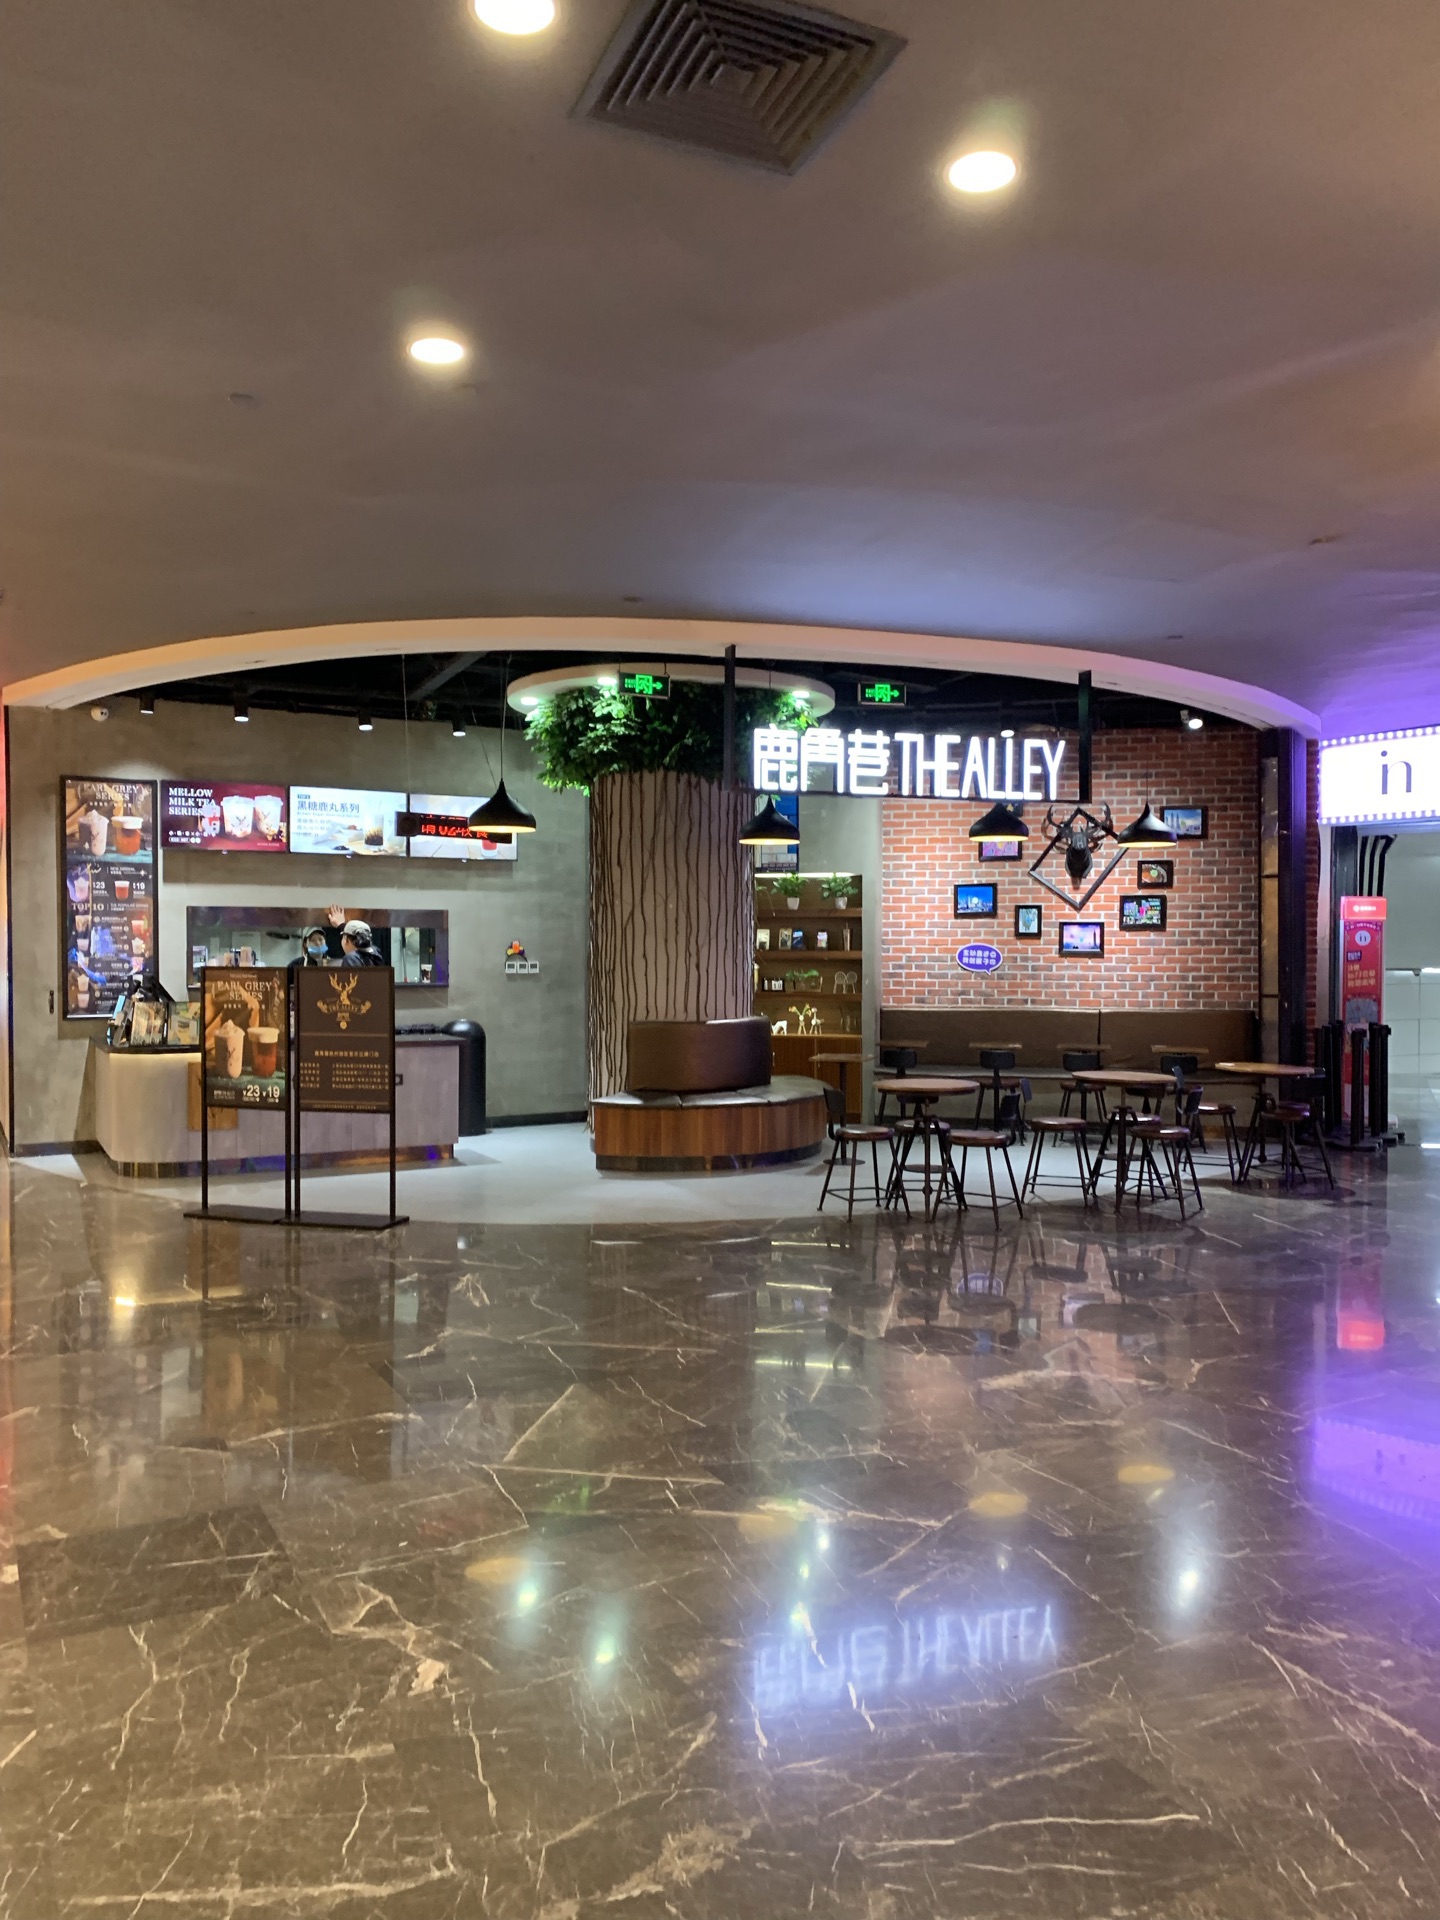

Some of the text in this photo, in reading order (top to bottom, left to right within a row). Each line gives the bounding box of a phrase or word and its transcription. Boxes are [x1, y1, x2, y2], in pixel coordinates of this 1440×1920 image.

[753, 723, 891, 796] 鹿角巷
[1380, 750, 1412, 795] in
[112, 784, 139, 793] GREY
[169, 787, 213, 798] MELLOW
[169, 797, 216, 807] MILK TEA
[297, 800, 360, 813] 黑糖鹿丸系列
[169, 807, 203, 816] SERIES
[92, 903, 105, 911] 10
[217, 981, 272, 992] EARL GREY
